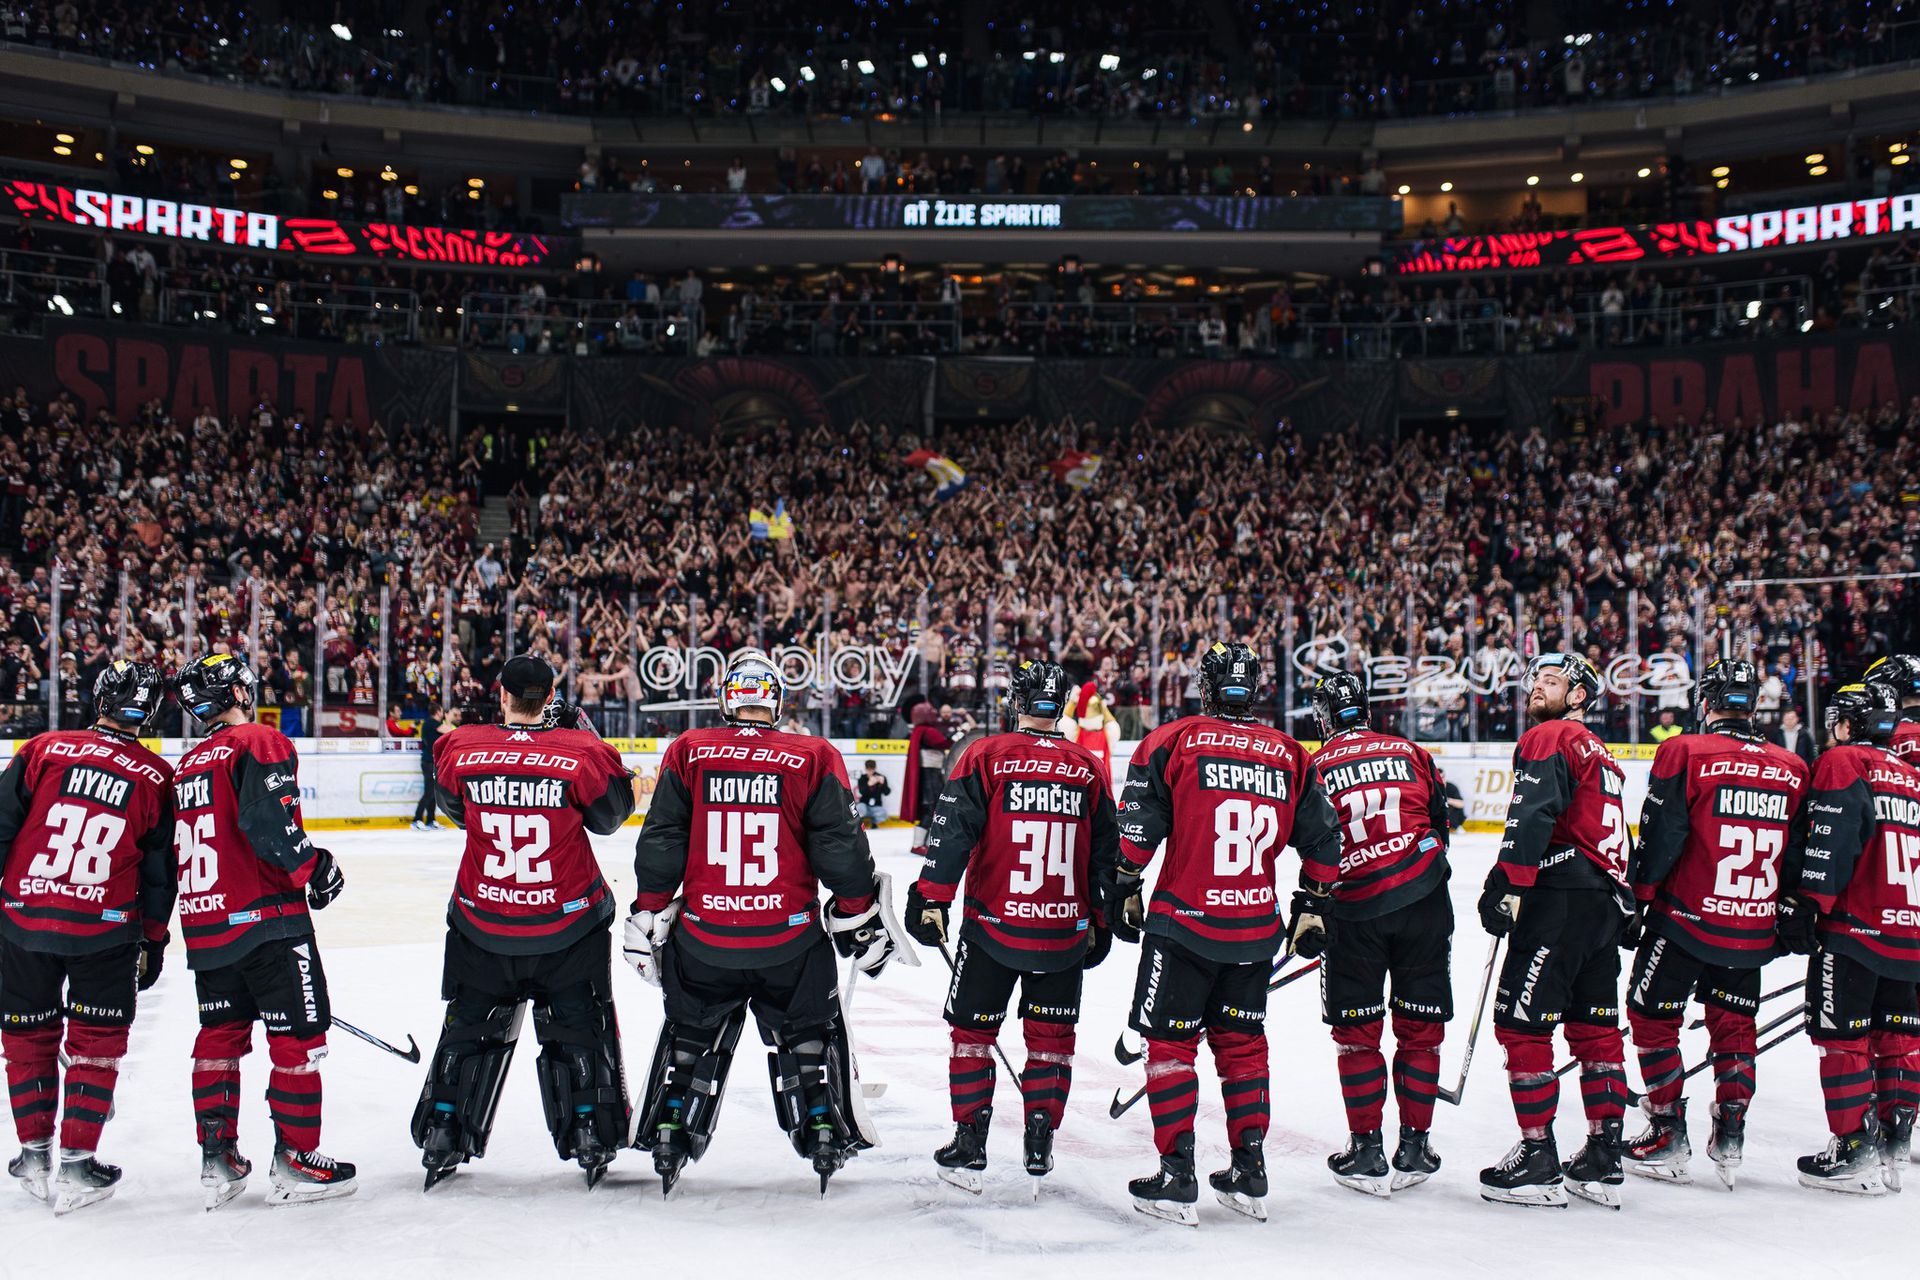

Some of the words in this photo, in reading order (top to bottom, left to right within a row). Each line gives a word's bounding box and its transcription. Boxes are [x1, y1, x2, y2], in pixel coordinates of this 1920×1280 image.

[75, 188, 278, 249] SPARTA
[904, 200, 930, 226] AŤ
[934, 200, 976, 226] ŽIJE
[980, 204, 1061, 226] SPARTA!
[1717, 193, 1920, 252] SPARTA
[55, 334, 372, 434] SPARTA
[1590, 343, 1899, 430] PRAHA
[640, 631, 918, 707] onplay
[1233, 662, 1245, 674] 80
[181, 683, 193, 697] 26
[1045, 677, 1056, 690] 34
[1185, 732, 1249, 749] LOUDA
[113, 753, 165, 785] AUTO
[456, 751, 522, 767] LOUDA
[522, 752, 579, 771] AUTO
[688, 745, 750, 764] LOUDA
[751, 748, 806, 769] AUTO
[993, 759, 1053, 776] LOUDA
[1700, 761, 1759, 778] LOUDA
[67, 767, 129, 807] HYKA
[1205, 762, 1287, 801] SEPPÄLÄ
[1324, 758, 1411, 795] CHLAPÍK
[467, 776, 563, 808] KOŘENÁŘ
[709, 774, 778, 805] KOVÁŘ
[1009, 783, 1083, 817] ŠPAČEK
[1126, 801, 1141, 812] KB
[1340, 787, 1401, 844] 14
[1719, 788, 1789, 820] KOUSAL
[1815, 824, 1832, 835] KB
[28, 803, 127, 885] 38
[173, 813, 219, 894] 26
[480, 811, 553, 883] 32
[707, 811, 779, 887] 43
[1338, 832, 1416, 874] SENCOR
[1009, 820, 1077, 896] 34
[1539, 848, 1576, 870] AUER
[1713, 824, 1783, 900] 23
[19, 878, 106, 903] SENCOR
[477, 883, 557, 906] SENCOR
[702, 894, 783, 911] SENCOR
[1206, 888, 1274, 906] SENCOR
[179, 893, 226, 915] ENCOR
[1004, 901, 1080, 919] SENCOR
[1175, 909, 1205, 917] ATLETICO
[1671, 909, 1702, 921] ATLETICO
[1702, 897, 1777, 917] SENCOR
[1850, 928, 1881, 936] ATLETICO
[951, 941, 967, 1000] DAIKIN
[1520, 946, 1551, 1007] DAIKIN
[1640, 937, 1667, 992] DAIKIN
[298, 960, 317, 1022] DAIKIN
[1144, 949, 1163, 1013] DAIKIN
[1822, 952, 1834, 1014] DAIKIN
[70, 1002, 123, 1018] FORTUNA
[1028, 1003, 1077, 1016] FORTUNA
[1341, 1003, 1385, 1018] FORTUNA
[1394, 996, 1441, 1014] FORTUNA
[1711, 988, 1756, 1008] FORTUNA
[4, 1008, 58, 1023] FORTUNA
[1222, 1004, 1265, 1020] FORTUNA
